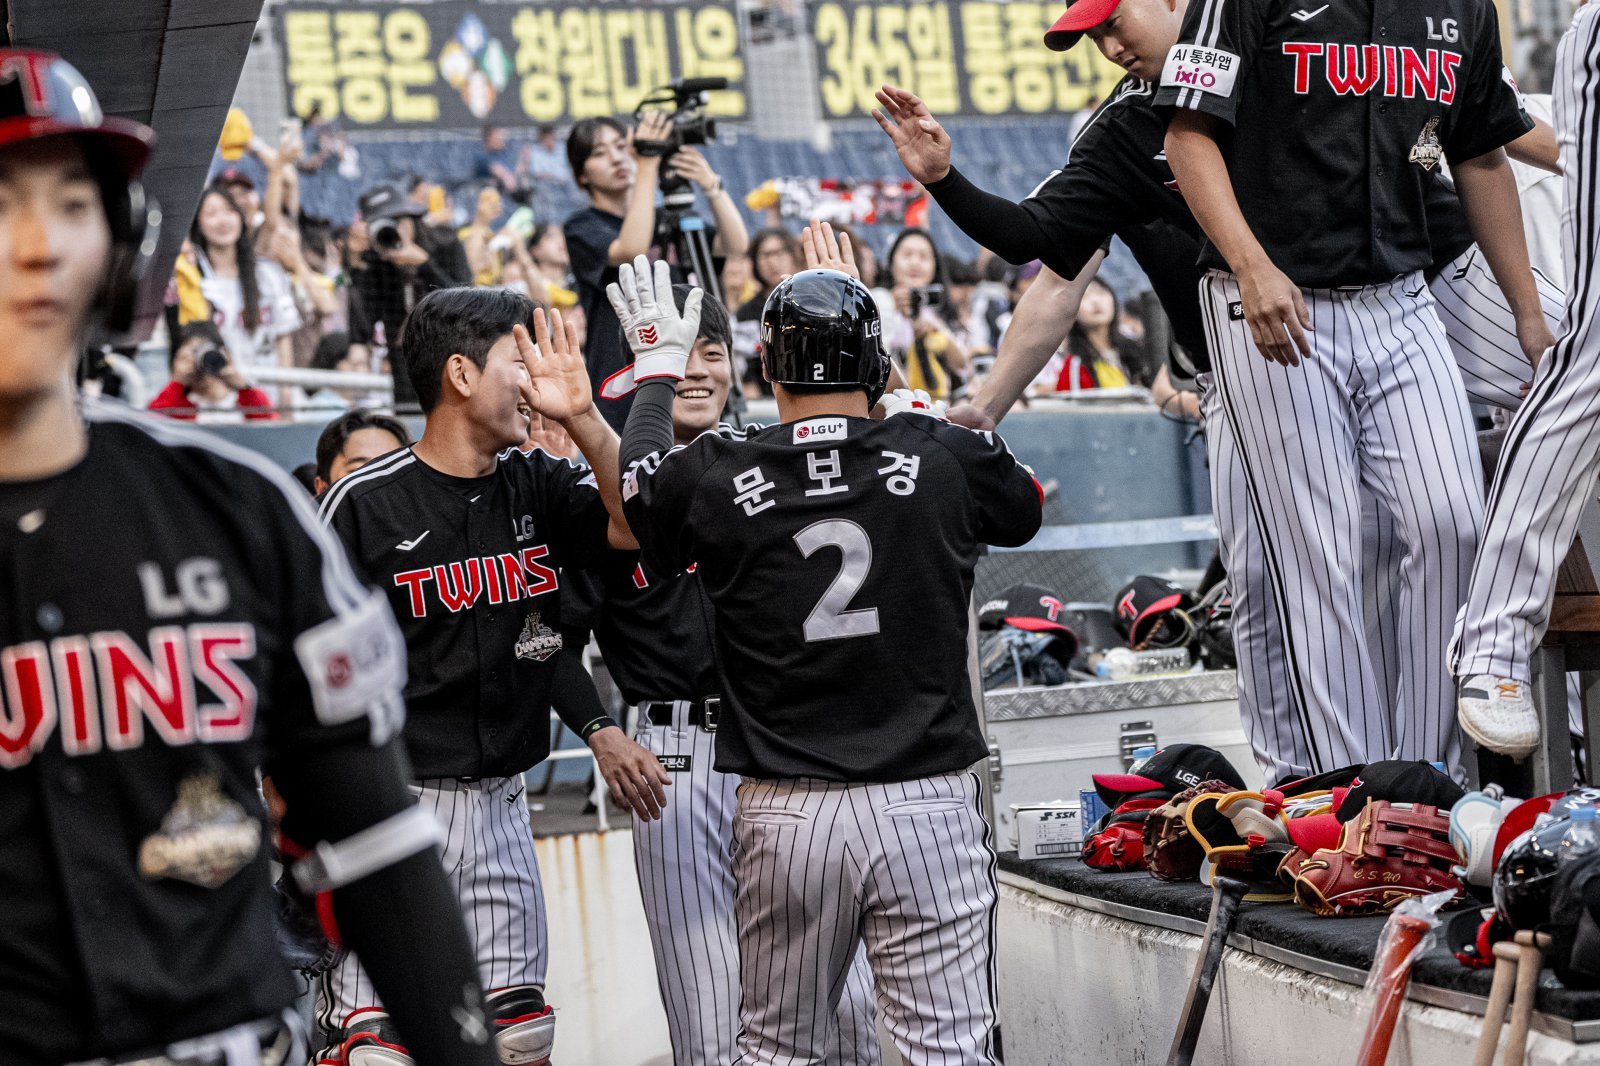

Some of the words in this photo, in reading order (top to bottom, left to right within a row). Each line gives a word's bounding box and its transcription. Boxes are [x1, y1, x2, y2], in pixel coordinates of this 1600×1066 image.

[1425, 16, 1459, 43] LG
[815, 3, 961, 116] 365일
[1172, 49, 1187, 61] AI
[1190, 49, 1232, 71] 통화앱
[1282, 42, 1462, 105] TWINS
[813, 363, 824, 380] 2
[512, 514, 535, 541] LG
[137, 556, 231, 617] LG
[394, 544, 558, 618] TWINS
[792, 518, 880, 642] 2
[1175, 769, 1200, 787] LGE
[1055, 811, 1077, 820] SSK
